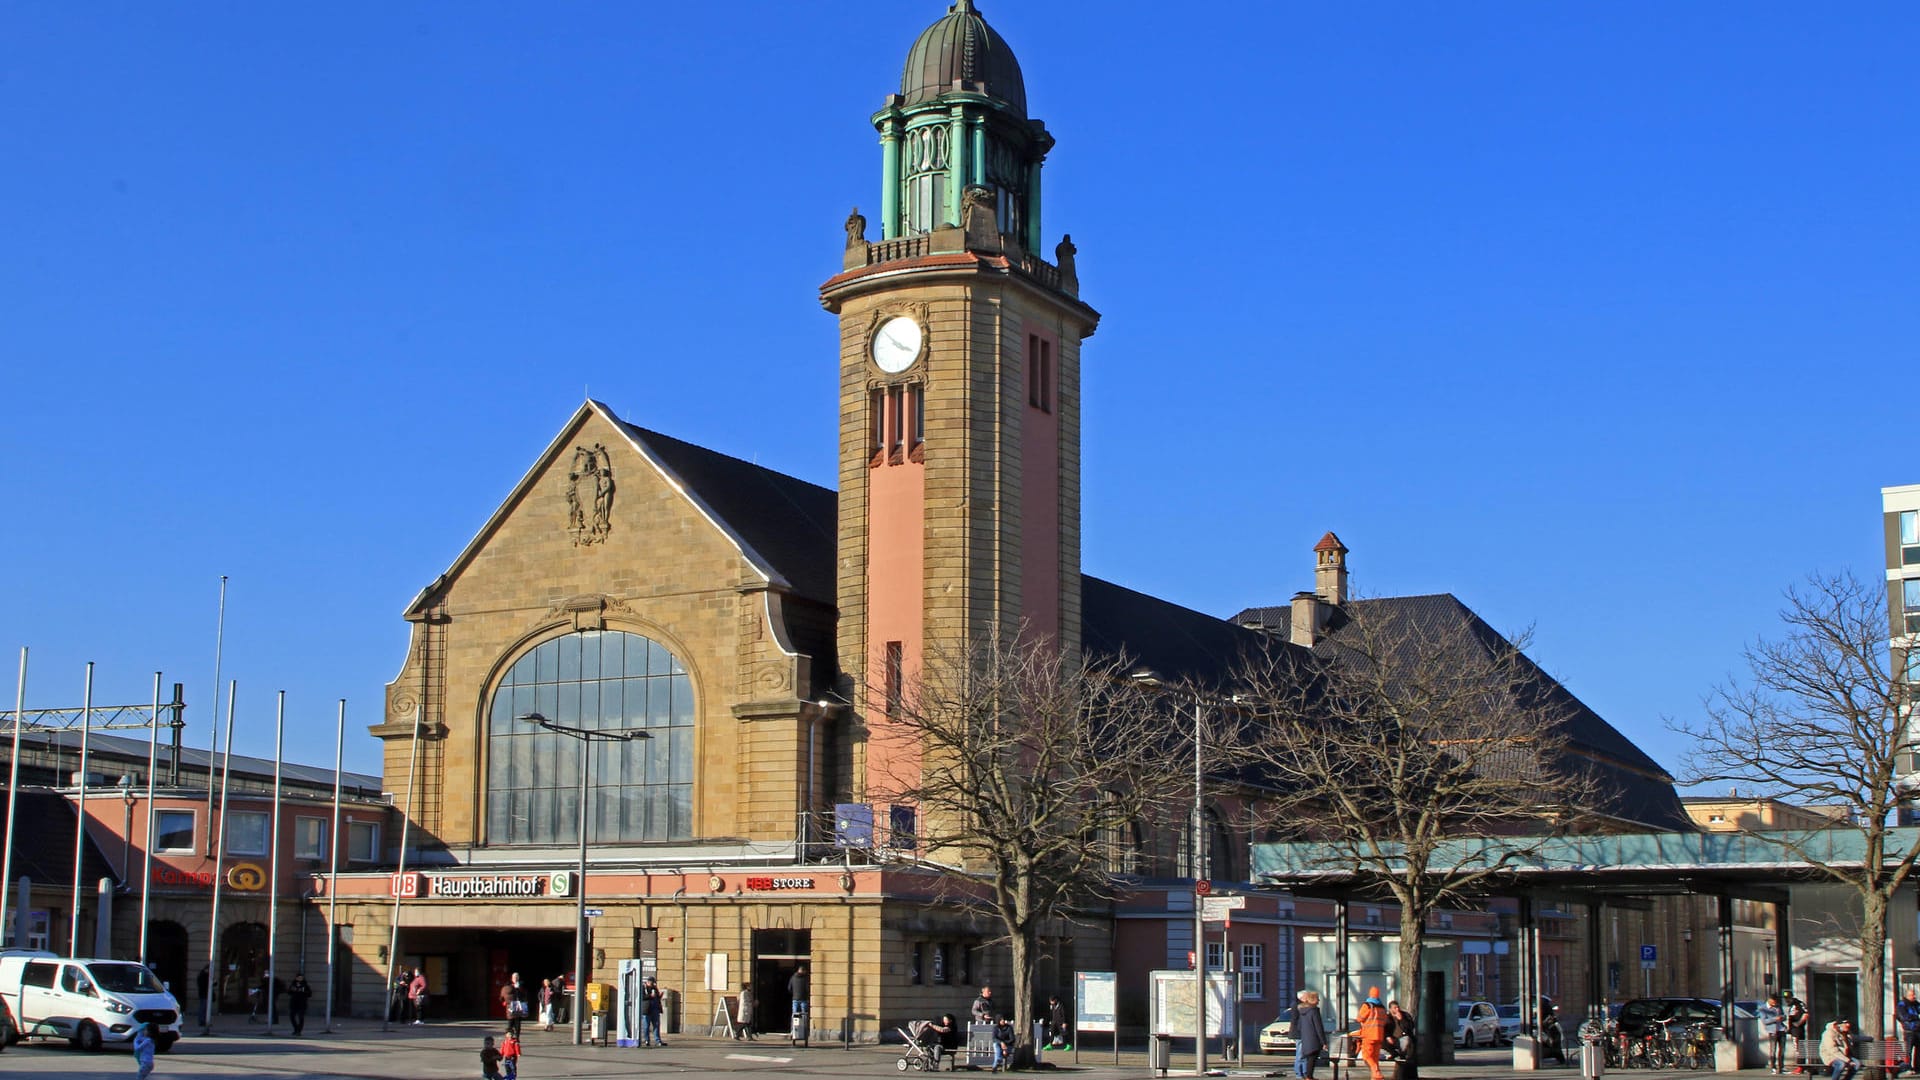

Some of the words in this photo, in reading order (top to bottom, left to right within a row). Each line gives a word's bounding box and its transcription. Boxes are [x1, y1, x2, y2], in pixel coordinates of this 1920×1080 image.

[433, 876, 538, 897] Hauptbahnhof
[552, 874, 567, 893] S
[773, 878, 810, 888] STORE
[1643, 947, 1653, 959] P
